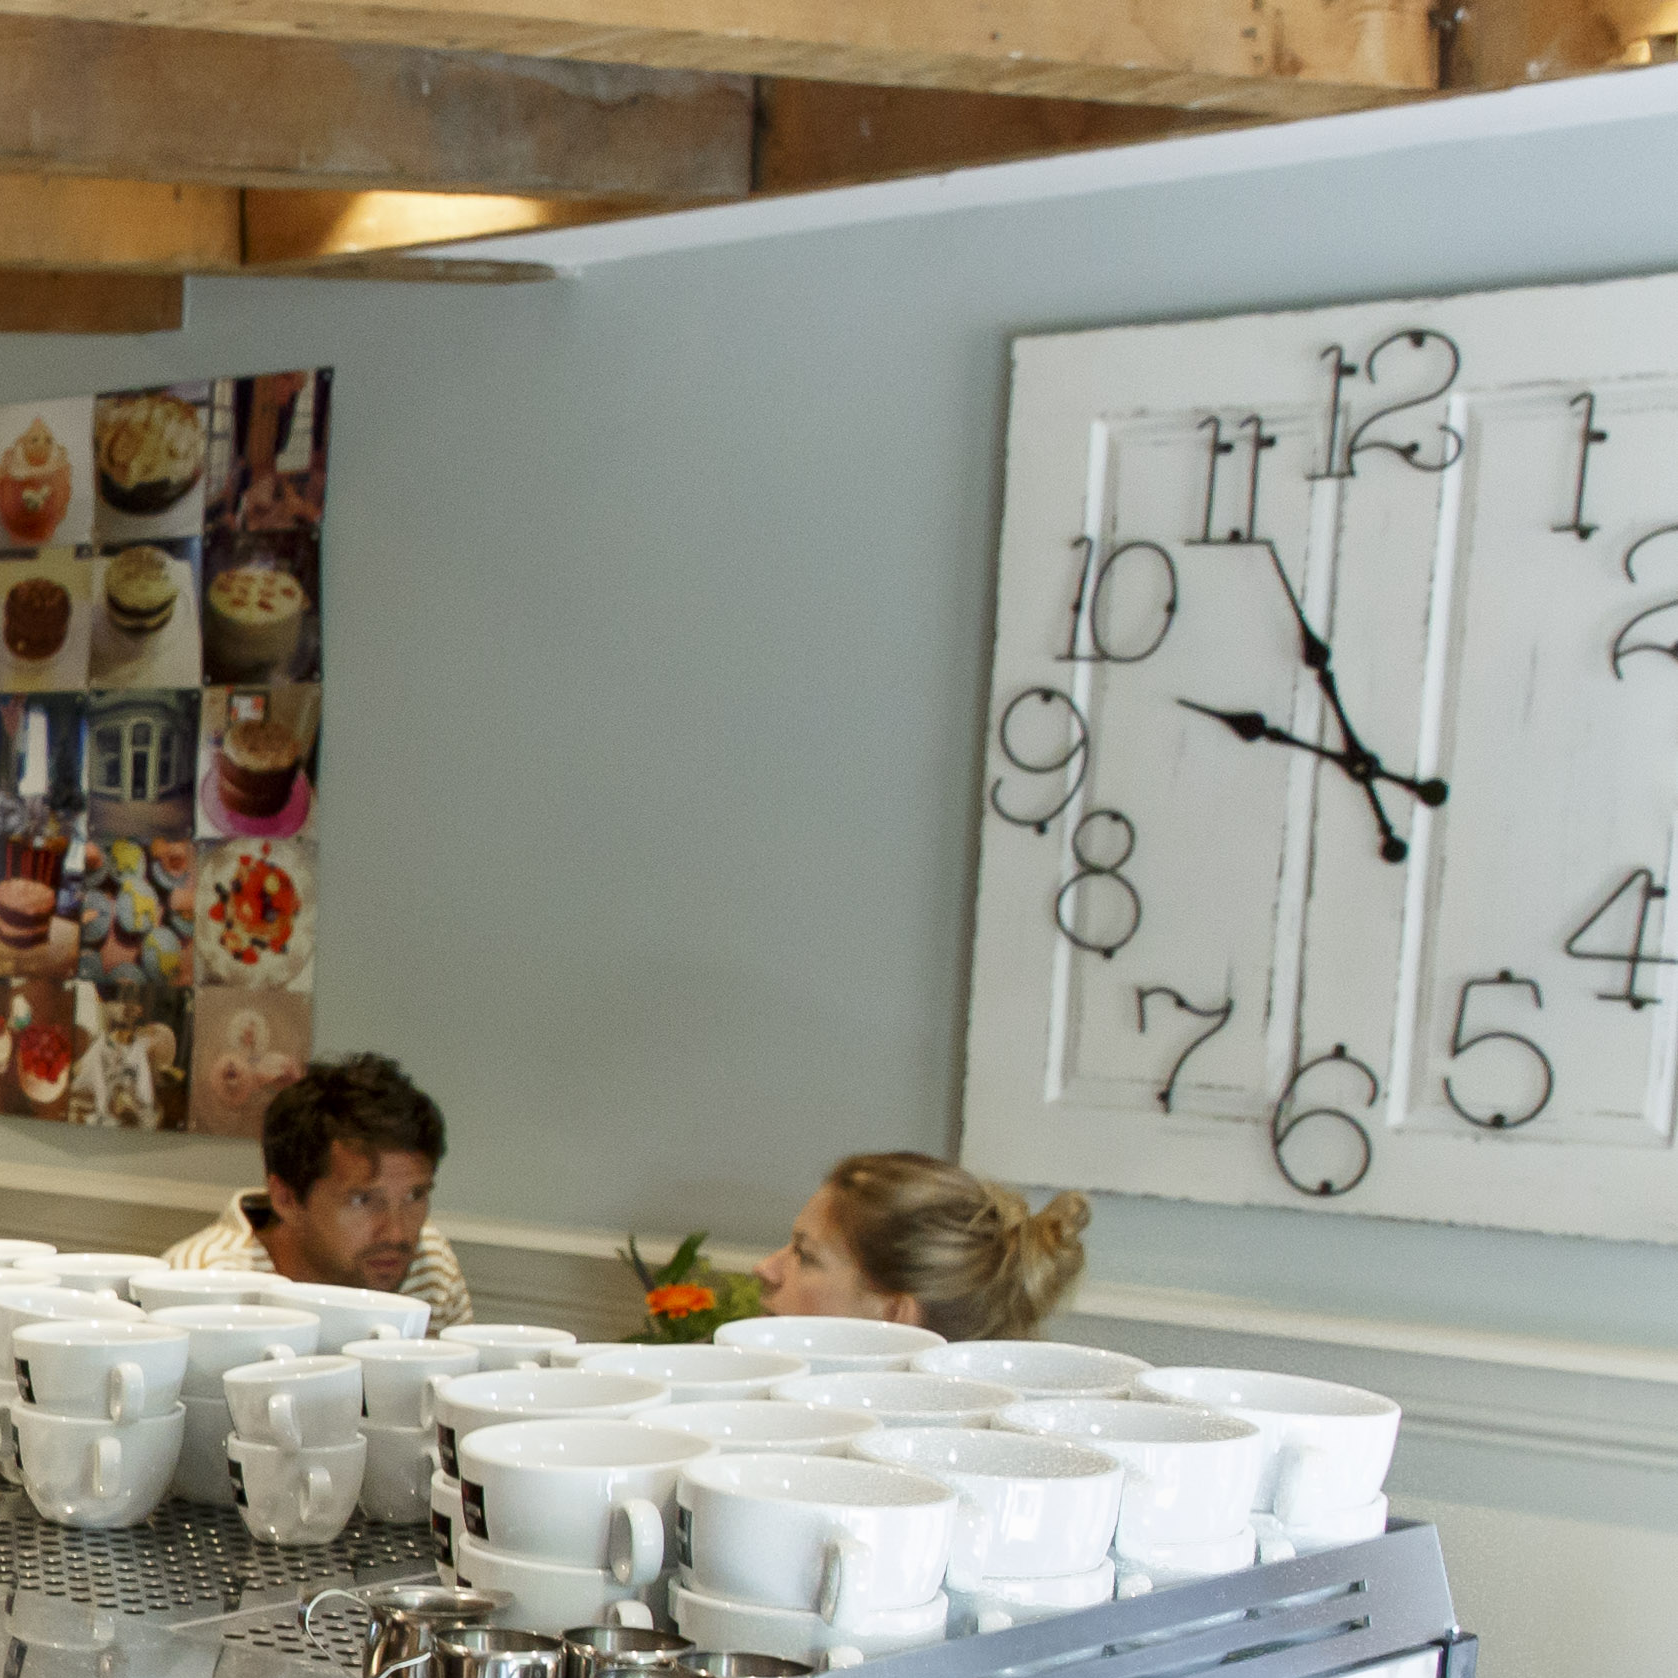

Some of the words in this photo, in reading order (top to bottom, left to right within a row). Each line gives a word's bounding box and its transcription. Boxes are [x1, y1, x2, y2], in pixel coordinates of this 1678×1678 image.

[1306, 328, 1464, 480] 12
[1551, 392, 1607, 540] 1
[1186, 415, 1276, 546] 11
[1056, 535, 1179, 663] 10
[990, 686, 1090, 835] 9
[1055, 808, 1142, 959] 8
[1564, 868, 1678, 1009] 4
[1135, 985, 1234, 1114] 7
[1273, 1043, 1380, 1197] 6
[1444, 969, 1553, 1129] 5
